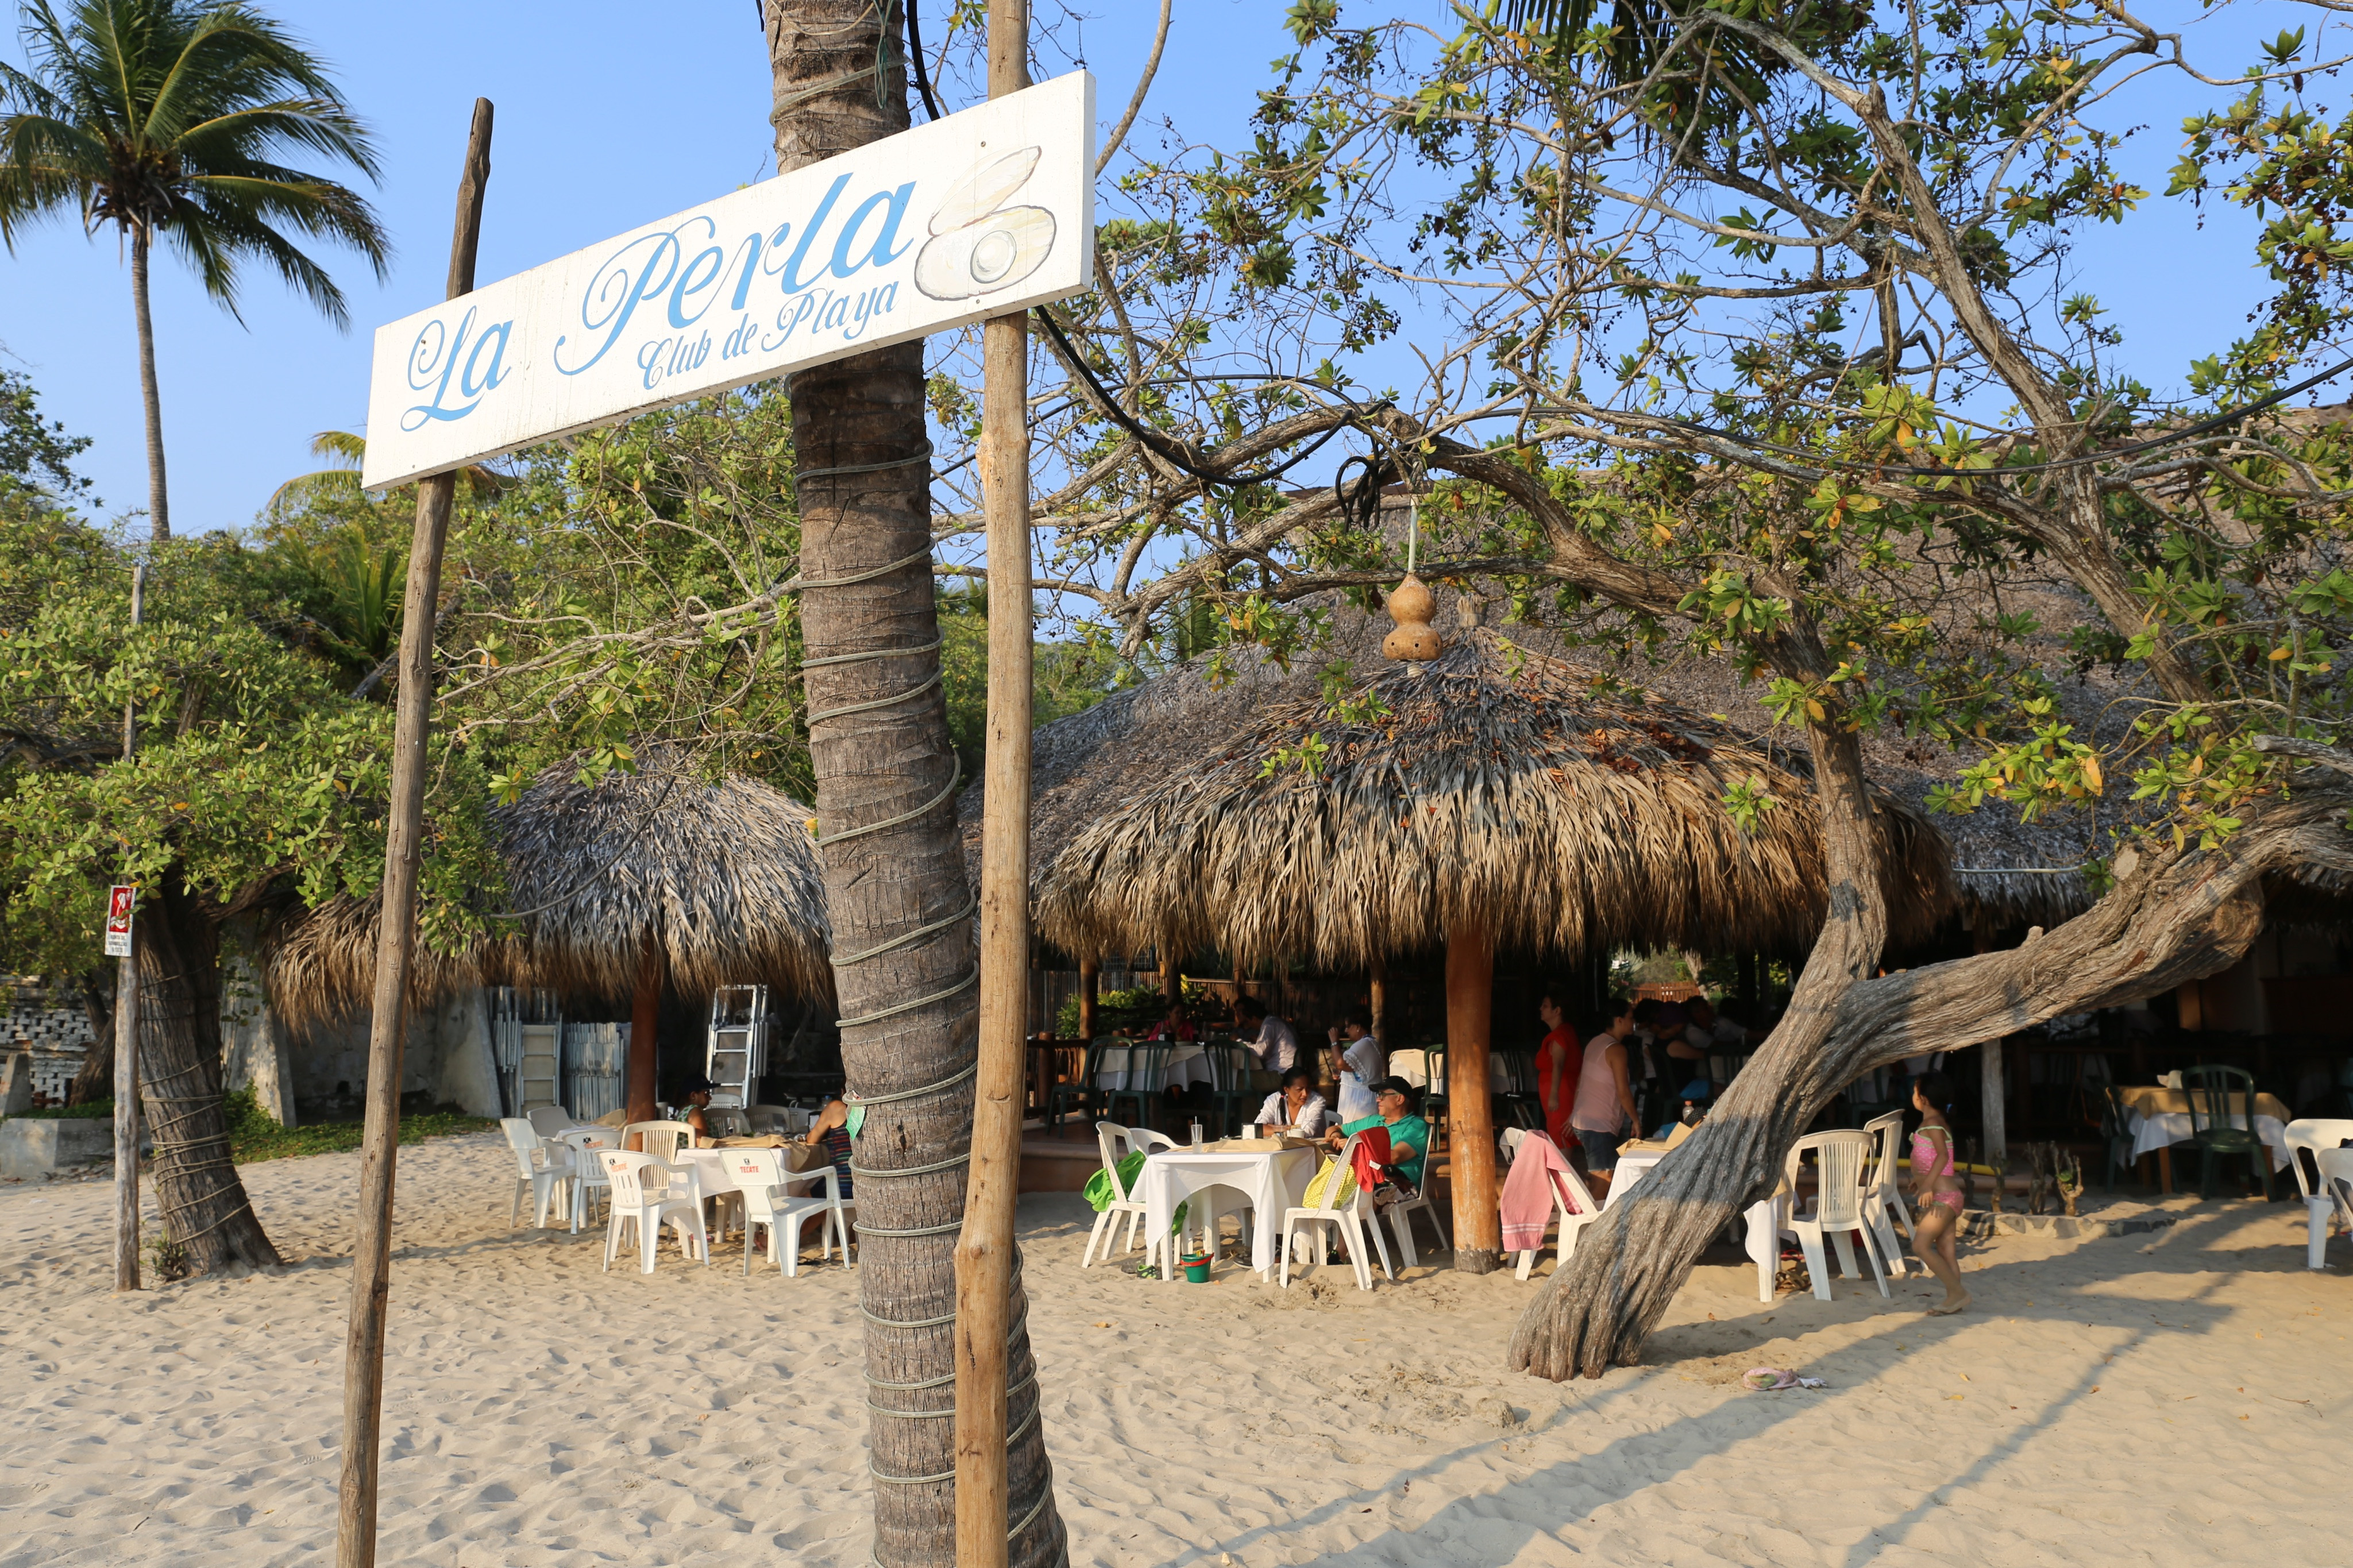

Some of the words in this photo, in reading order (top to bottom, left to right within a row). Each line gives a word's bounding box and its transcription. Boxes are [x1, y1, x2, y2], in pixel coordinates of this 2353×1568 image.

[402, 306, 514, 431] La
[554, 173, 917, 376] Perla
[637, 333, 713, 390] Club
[722, 314, 758, 361] de
[761, 281, 899, 352] Playa
[739, 1165, 759, 1173] TECATE
